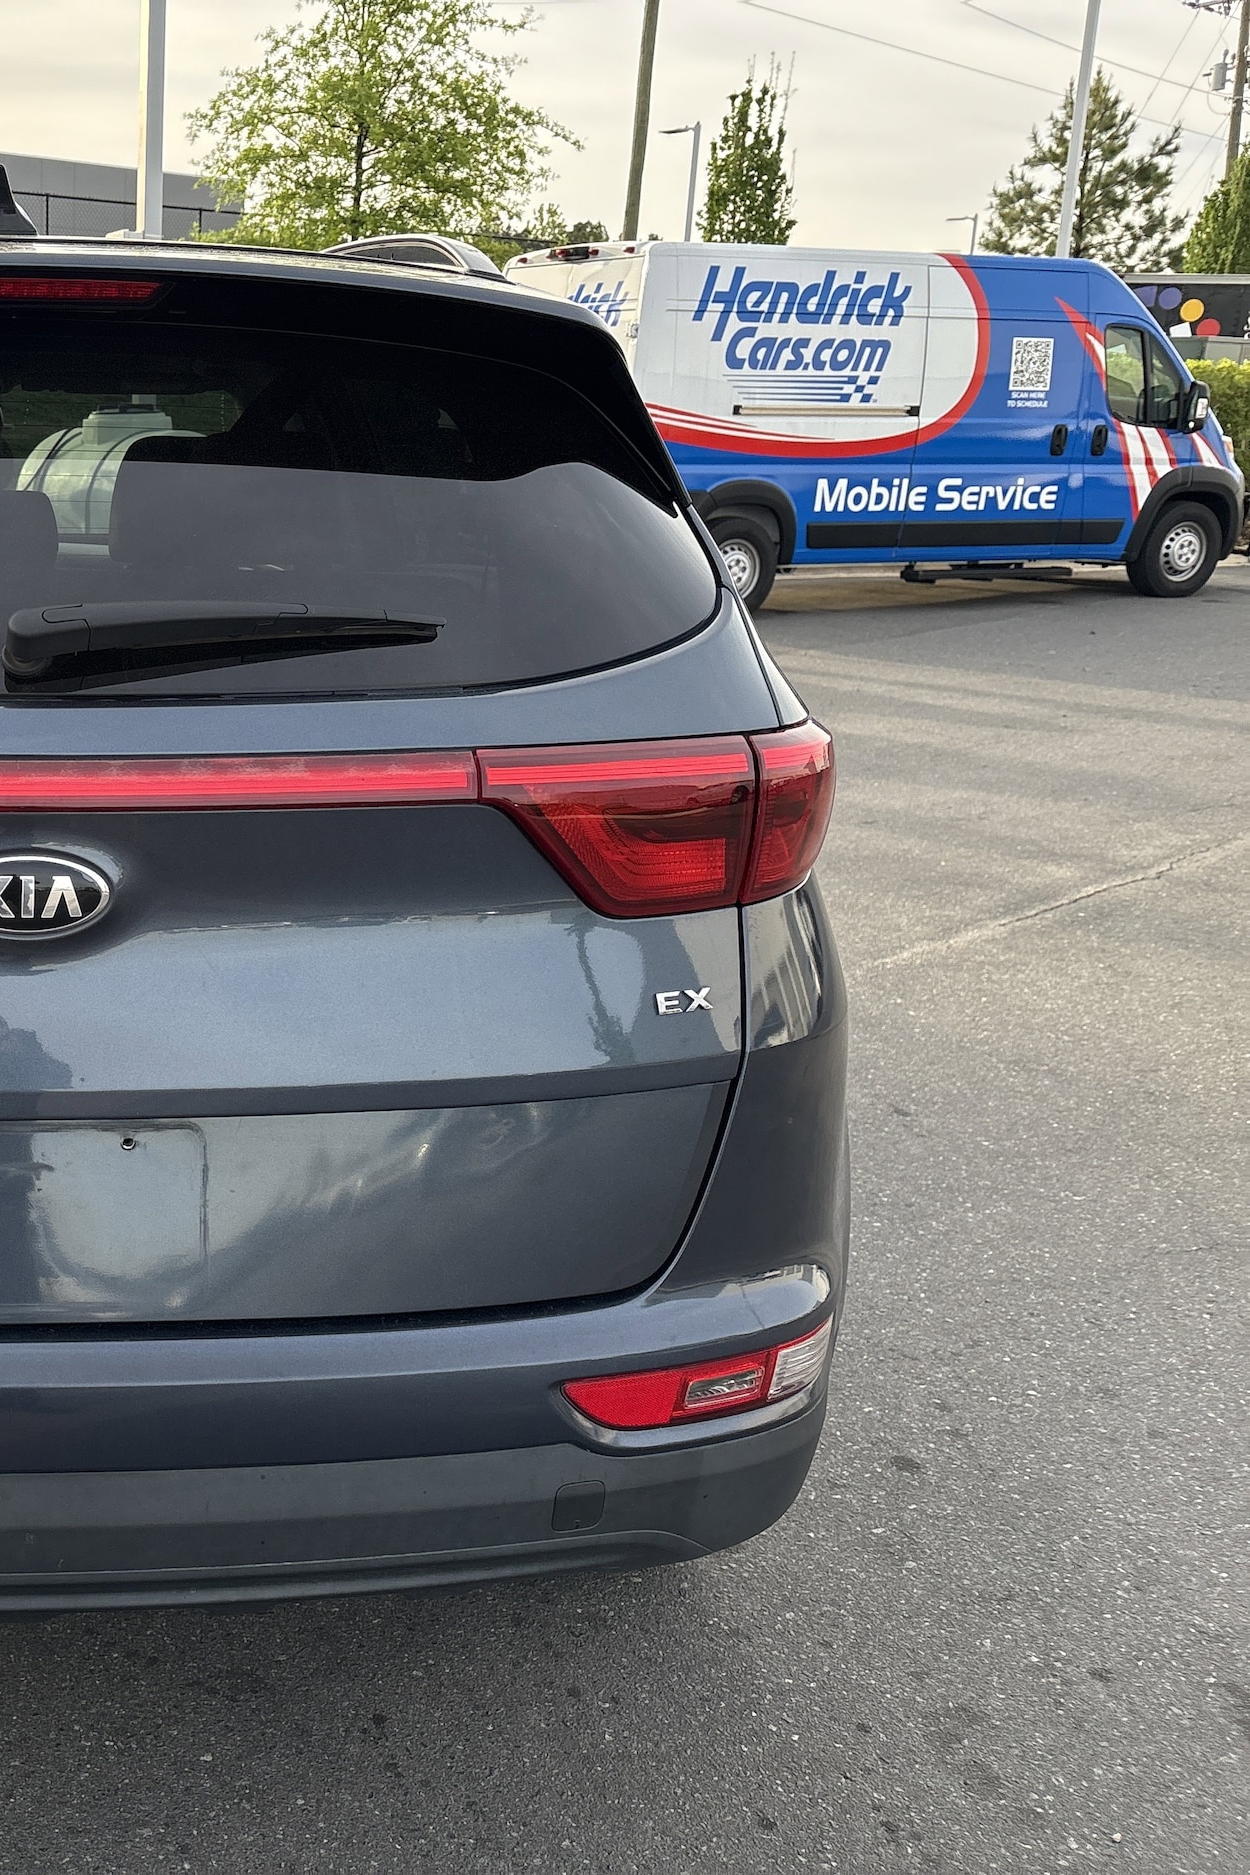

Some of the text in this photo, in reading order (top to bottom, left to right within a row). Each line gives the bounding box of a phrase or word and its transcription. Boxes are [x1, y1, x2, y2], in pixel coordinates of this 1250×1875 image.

[692, 265, 912, 341] Hendrick
[725, 326, 892, 372] Cars.com
[1007, 400, 1049, 408] TO SCHEDULE
[813, 477, 1059, 512] Mobile Service
[655, 986, 714, 1016] EX
